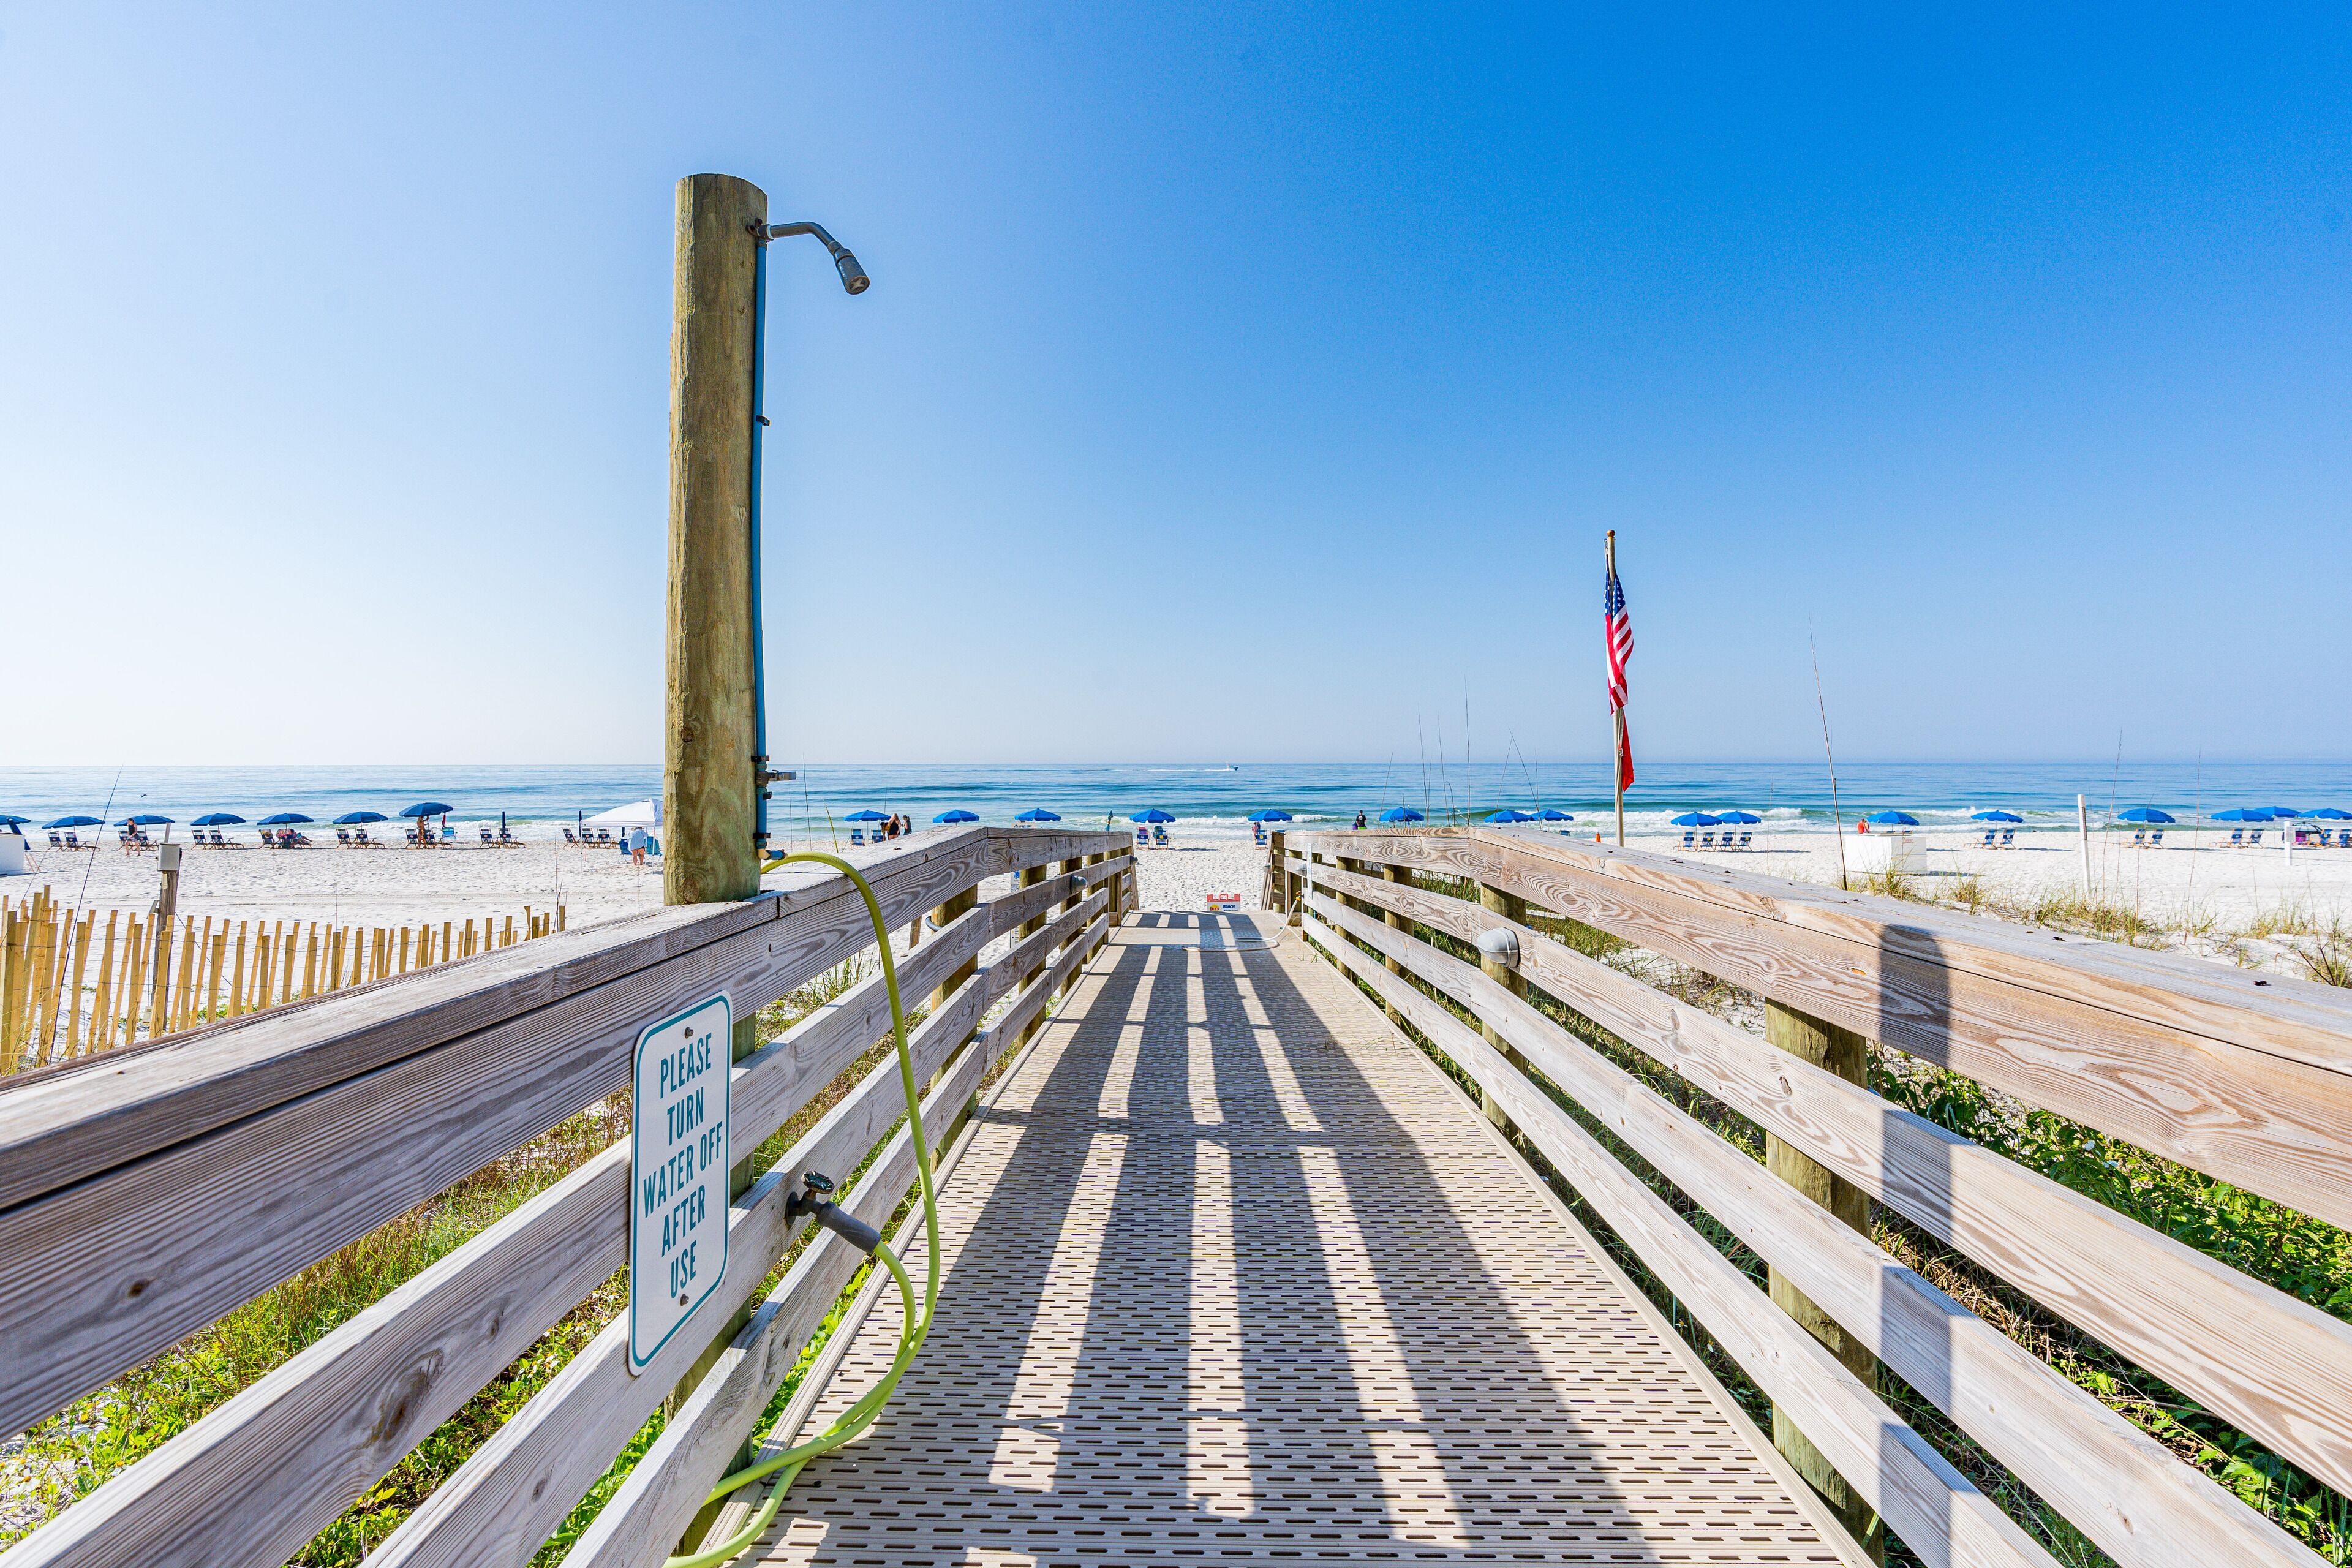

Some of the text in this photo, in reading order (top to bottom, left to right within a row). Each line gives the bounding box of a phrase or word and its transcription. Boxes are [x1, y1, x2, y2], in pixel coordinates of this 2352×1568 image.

[660, 1032, 712, 1099] PLEASE
[666, 1087, 704, 1147] TURN
[643, 1120, 723, 1219] WATER OFF
[661, 1185, 706, 1257] AFTER
[670, 1239, 697, 1299] USE
